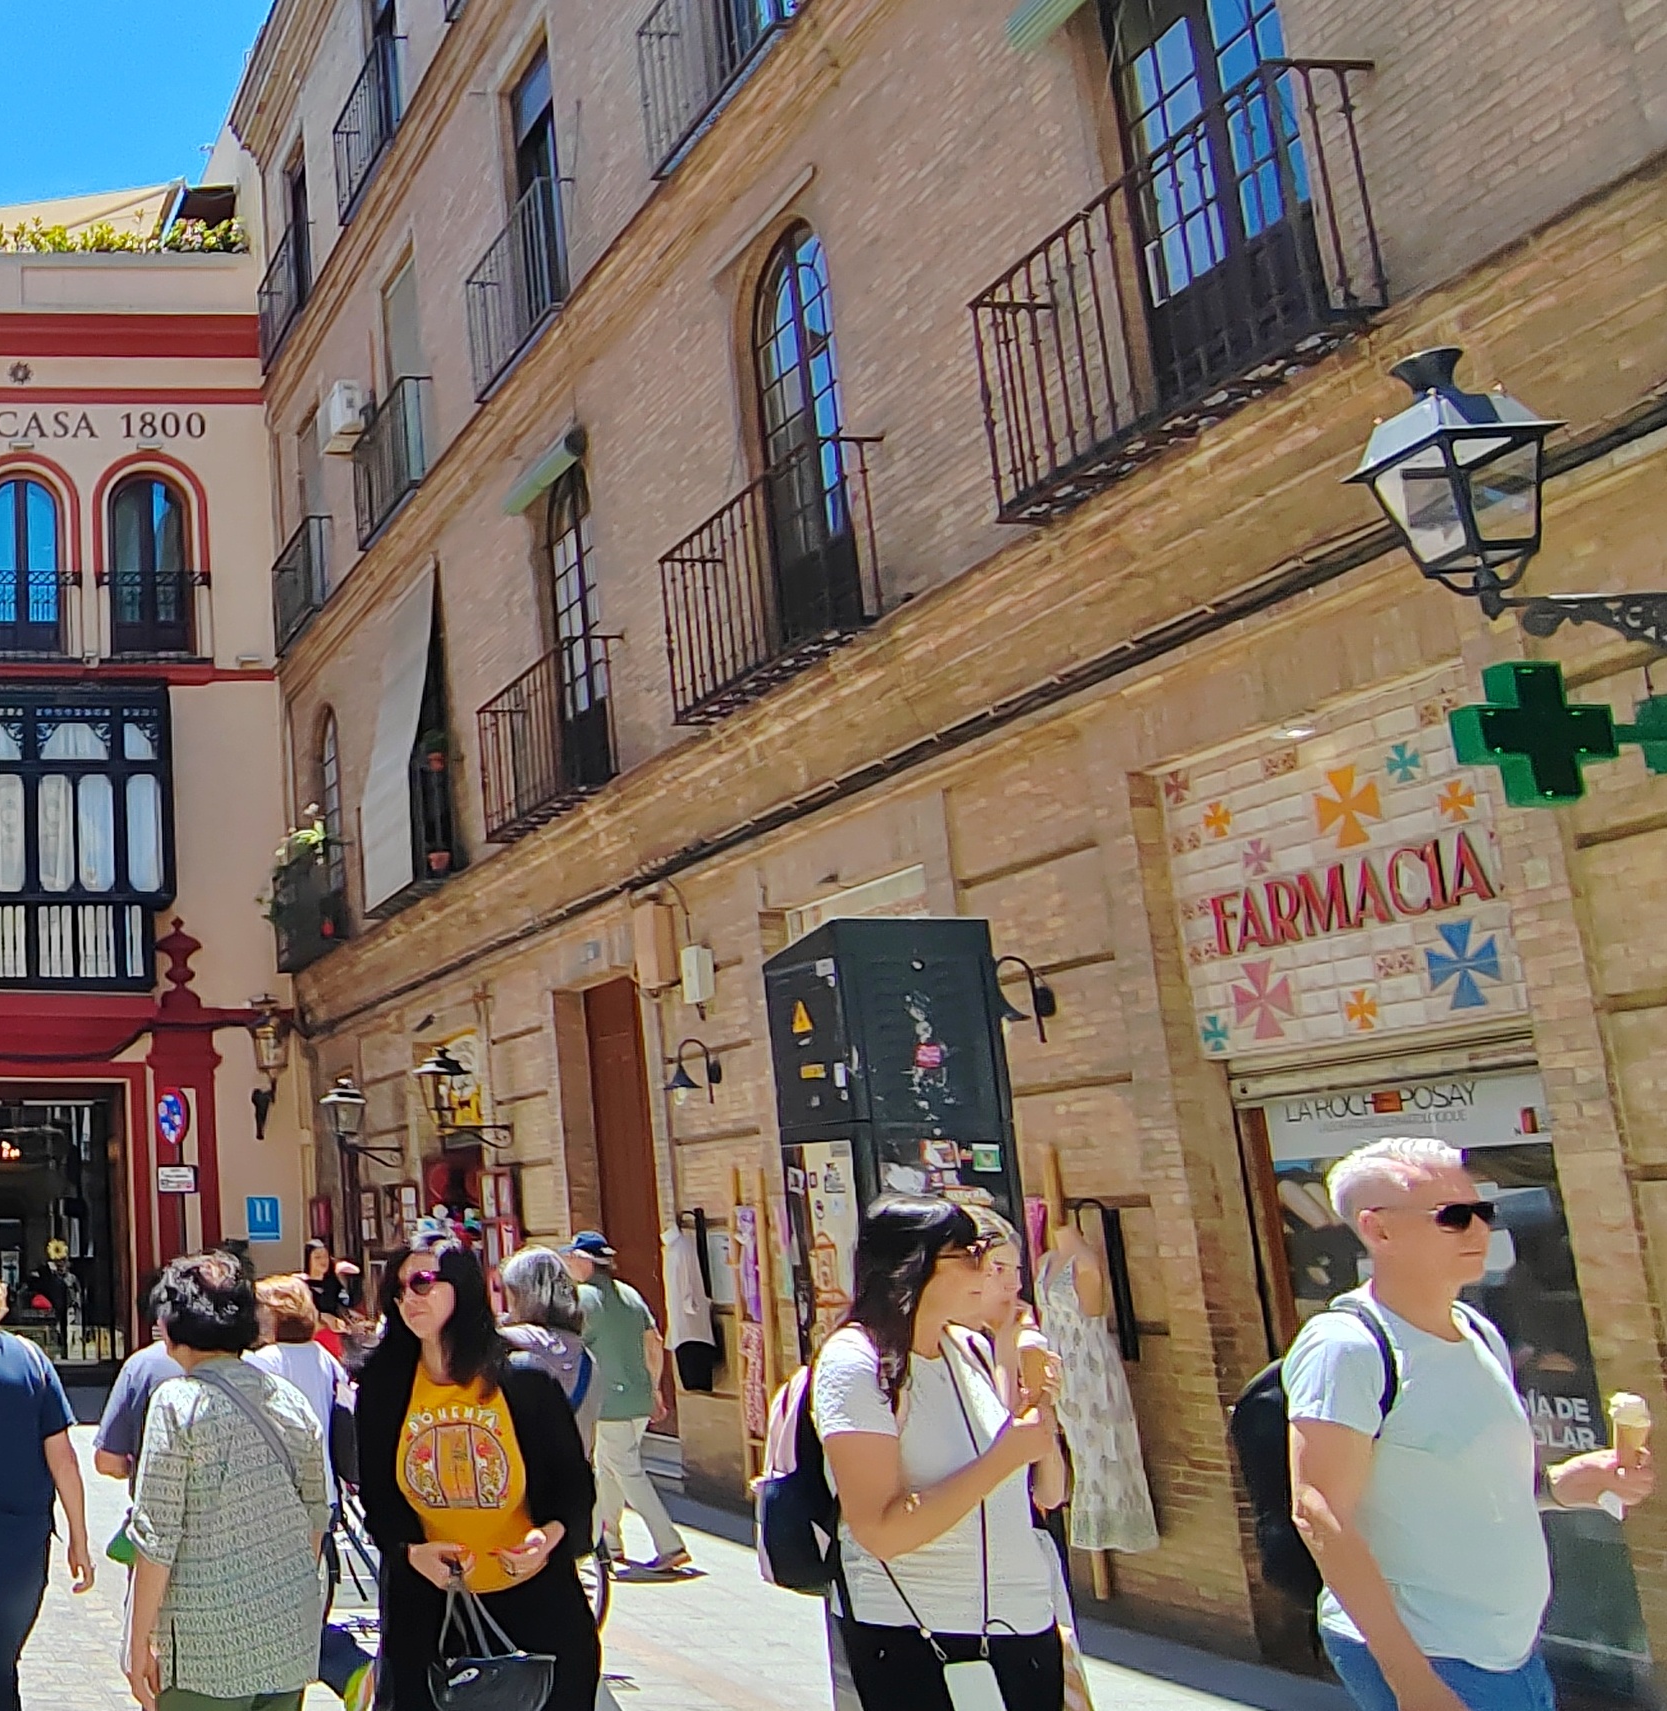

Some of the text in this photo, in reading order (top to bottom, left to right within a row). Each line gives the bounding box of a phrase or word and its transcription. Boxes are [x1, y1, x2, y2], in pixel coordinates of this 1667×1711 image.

[120, 410, 206, 438] 1800
[1209, 831, 1496, 956] FARMACIA
[1284, 1101, 1313, 1123] LA
[1553, 1396, 1592, 1423] DE
[1532, 1424, 1597, 1451] OLAR
